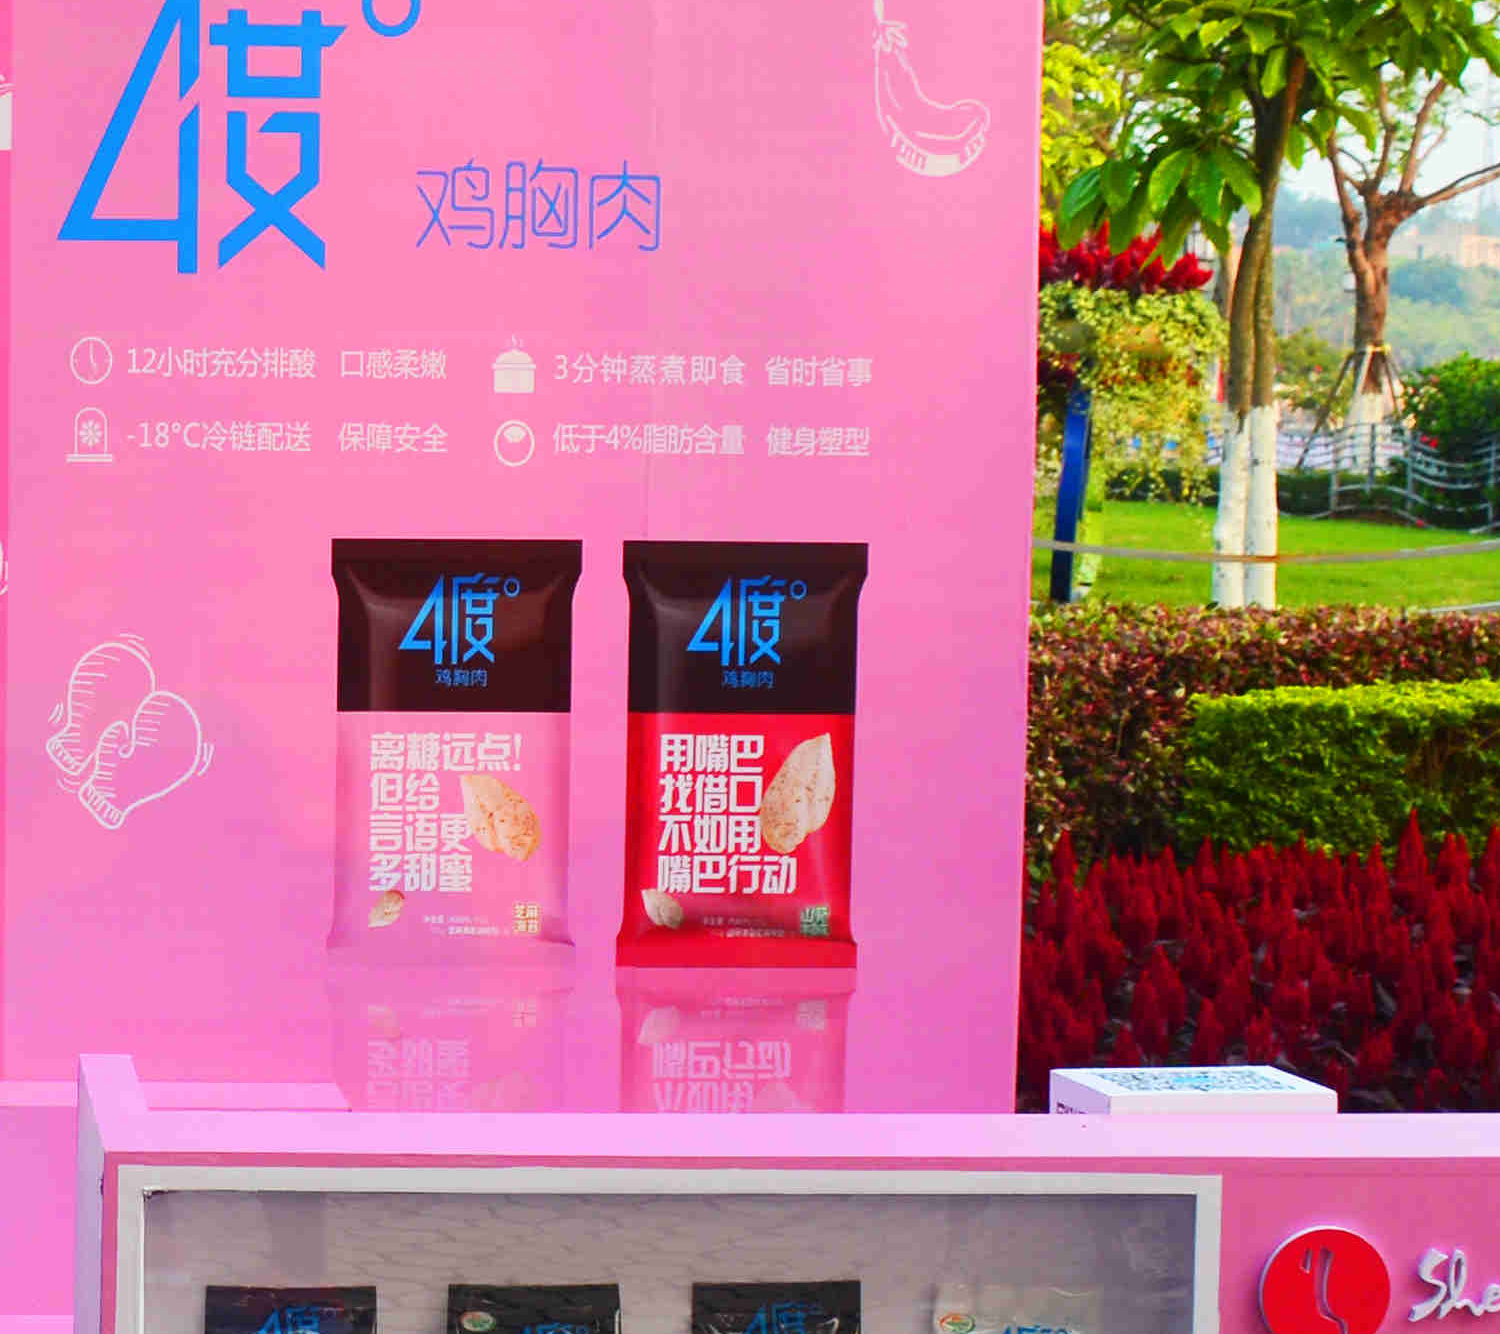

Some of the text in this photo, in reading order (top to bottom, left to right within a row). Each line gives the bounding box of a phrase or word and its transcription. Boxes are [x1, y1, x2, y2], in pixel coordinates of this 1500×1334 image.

[416, 160, 662, 251] 鸡胸肉
[127, 347, 447, 380] 12小时充分排酸 口感柔嫩
[554, 355, 873, 387] 3分钟蒸煮即食 省时省事
[338, 423, 448, 454] 保障安全
[553, 423, 870, 457] 低于4%脂肪含量 健身塑型
[435, 668, 488, 689] 鸡胸肉
[722, 670, 775, 690] 鸡胸肉
[659, 733, 764, 773] 用嘴巴
[370, 773, 440, 811] 但给
[659, 774, 763, 813] 找借口
[369, 813, 473, 853] 言语更
[657, 813, 762, 854] 不如用
[369, 854, 473, 893] 多甜蜜
[656, 854, 797, 895] 嘴巴行动
